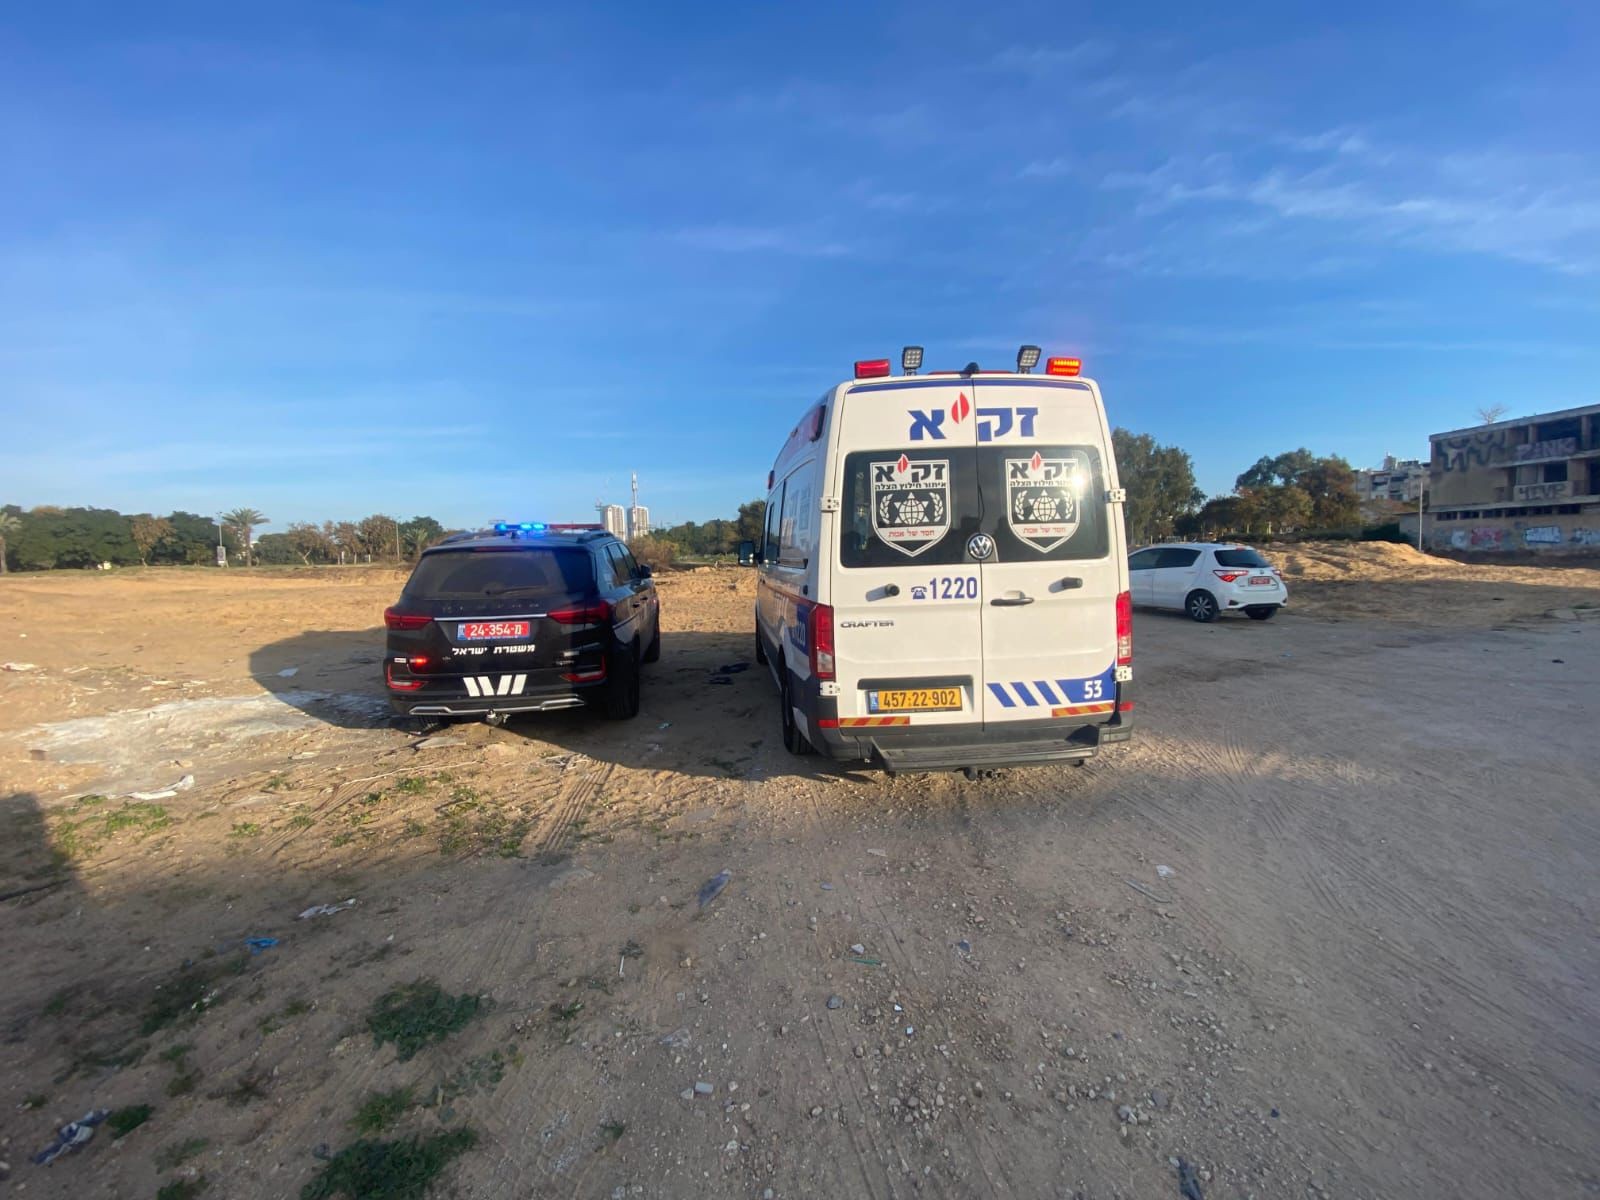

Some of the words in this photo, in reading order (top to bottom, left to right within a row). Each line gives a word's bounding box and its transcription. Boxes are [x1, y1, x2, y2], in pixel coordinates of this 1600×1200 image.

[929, 576, 978, 600] 1220
[840, 620, 895, 629] CRAFTER
[452, 646, 488, 656] ישראל
[493, 644, 536, 654] משטרת
[1084, 679, 1103, 699] 53
